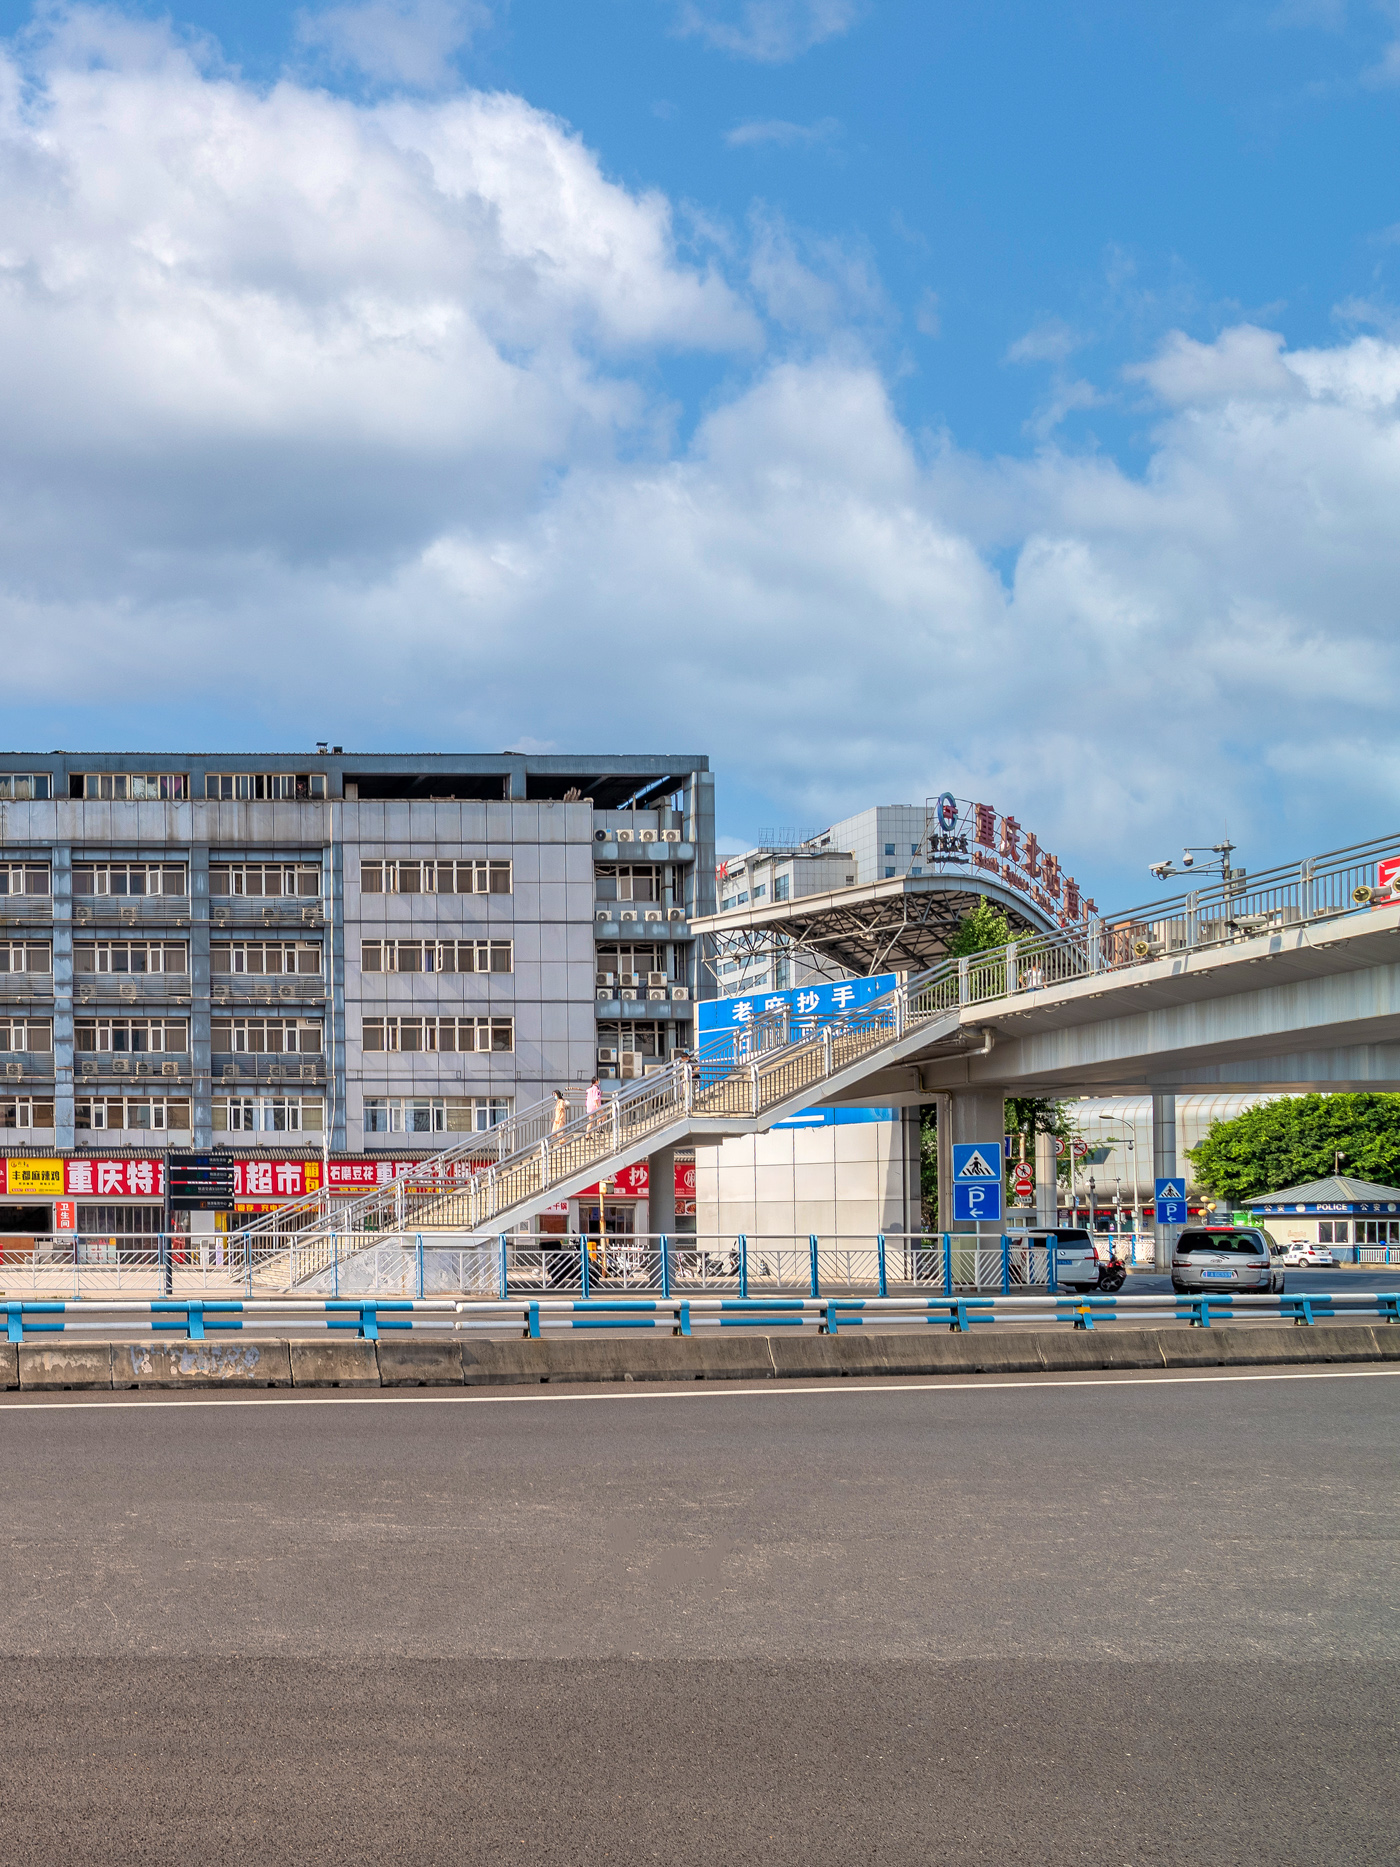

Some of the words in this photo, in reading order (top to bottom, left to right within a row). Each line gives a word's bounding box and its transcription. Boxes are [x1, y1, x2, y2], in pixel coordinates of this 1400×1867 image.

[732, 985, 855, 1022] 老麻抄手
[12, 1171, 60, 1181] 丰都麻辣鸡
[67, 1161, 301, 1194] 重庆特超市
[304, 1162, 319, 1194] 箱包
[330, 1166, 374, 1181] 石磨豆花
[969, 1191, 985, 1208] P
[1360, 1203, 1381, 1211] 公安
[60, 1203, 70, 1227] 卫生间
[234, 1204, 254, 1212] 寄存
[1167, 1206, 1177, 1216] P
[1264, 1204, 1285, 1212] 公安
